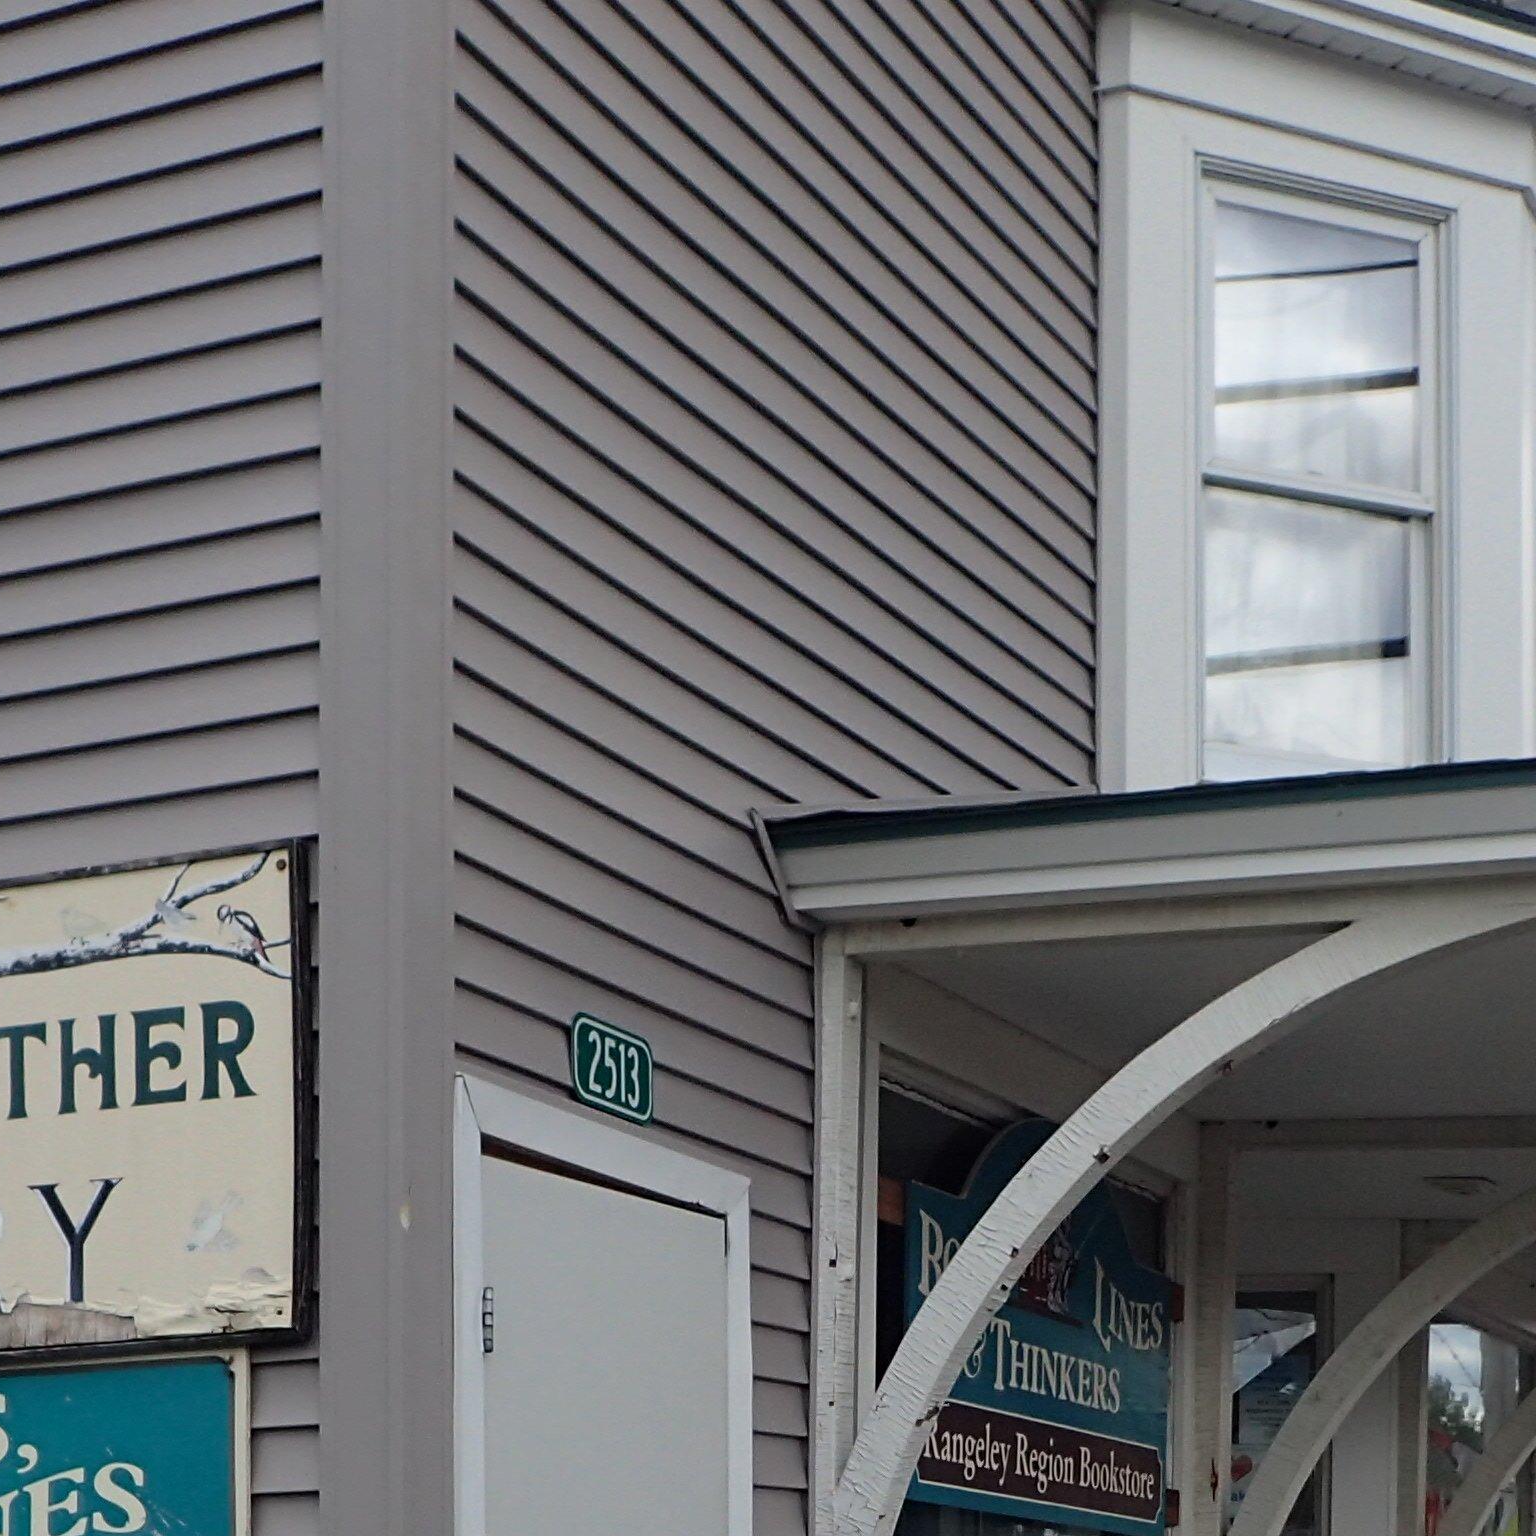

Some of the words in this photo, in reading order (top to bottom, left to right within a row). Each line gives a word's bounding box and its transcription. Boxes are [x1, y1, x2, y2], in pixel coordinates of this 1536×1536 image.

[588, 1030, 640, 1109] 2513
[1092, 1255, 1163, 1353] LINES
[990, 1318, 1120, 1414] THINKERS
[924, 1422, 1011, 1486] Rangeley
[1015, 1432, 1075, 1494] Region
[1079, 1446, 1156, 1500] Bookstore
